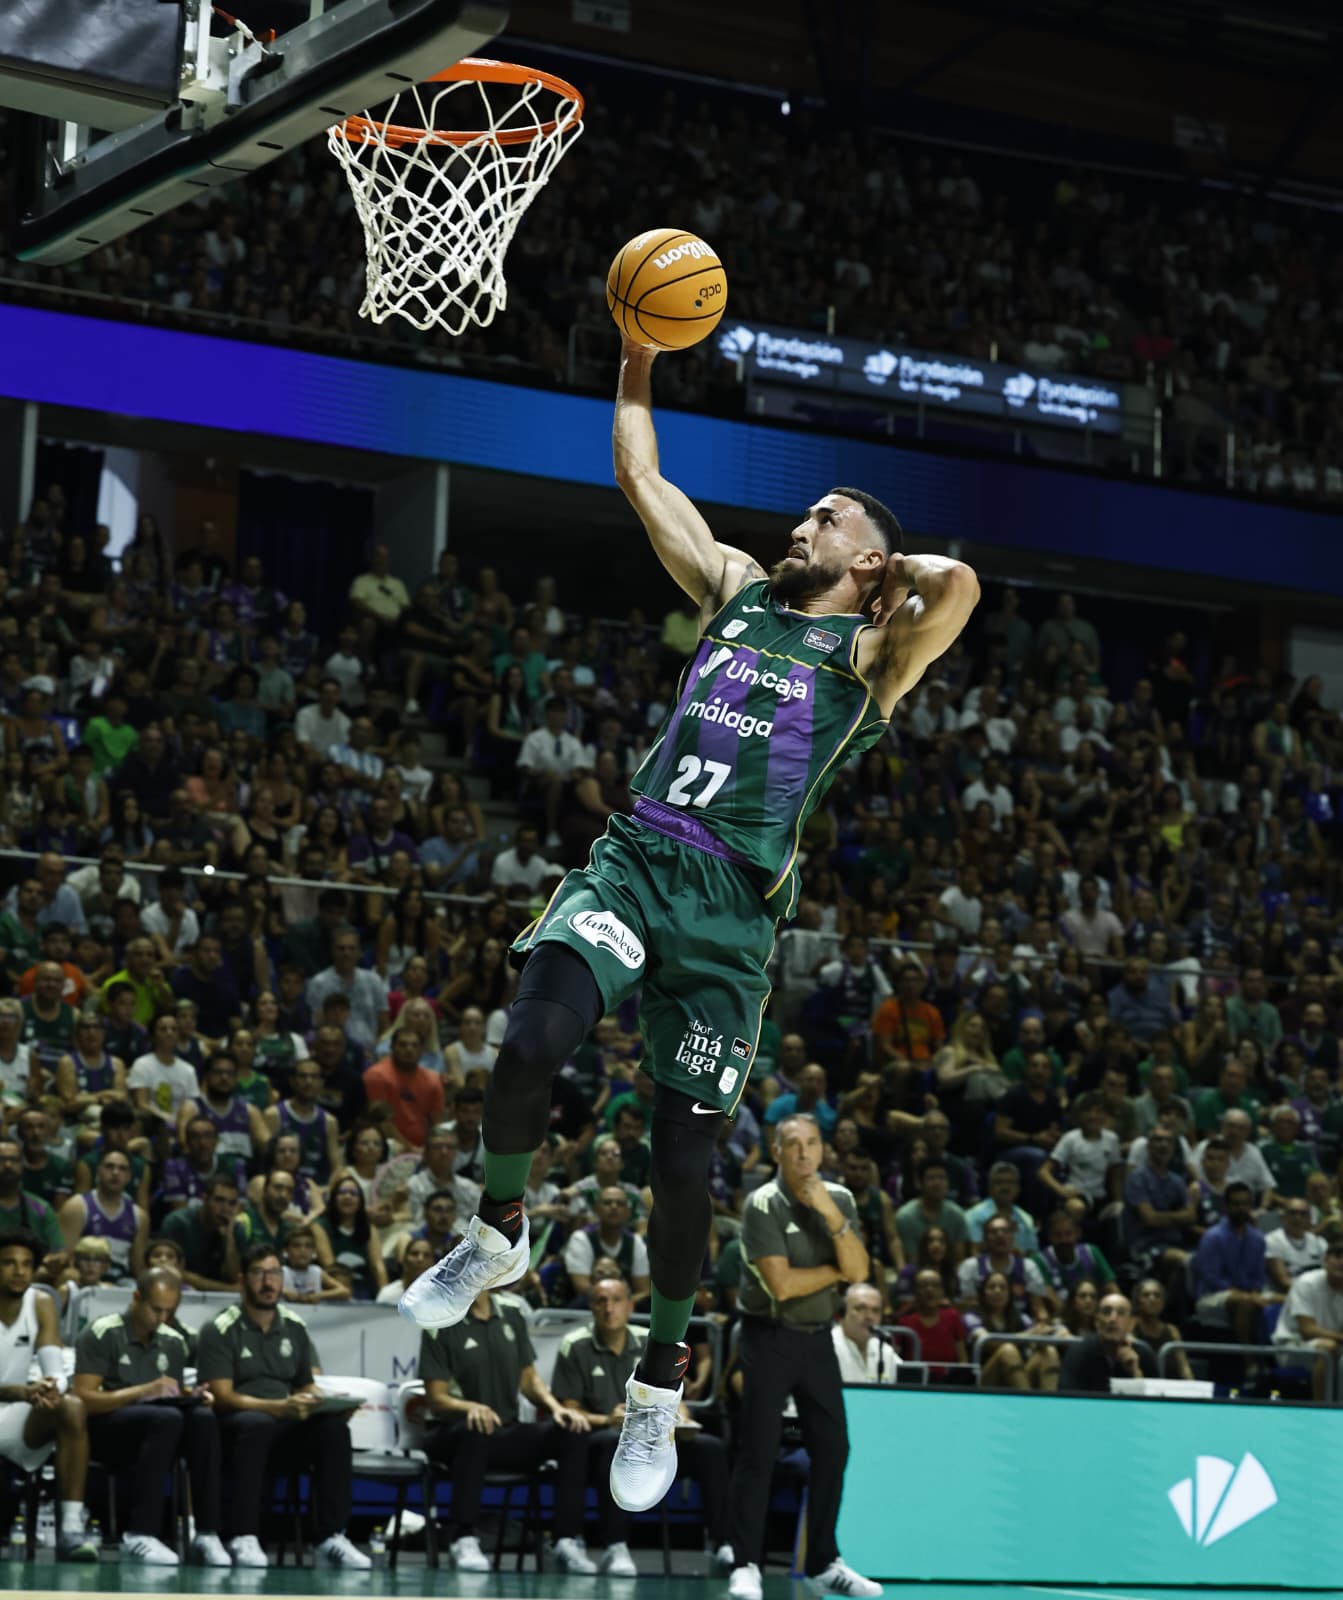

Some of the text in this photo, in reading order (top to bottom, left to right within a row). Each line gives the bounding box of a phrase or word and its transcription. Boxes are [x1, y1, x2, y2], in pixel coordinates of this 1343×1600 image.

[699, 283, 722, 300] acb
[725, 659, 808, 703] Unicaja
[685, 697, 773, 739] málaga
[666, 754, 732, 809] 27
[675, 1041, 717, 1075] laga
